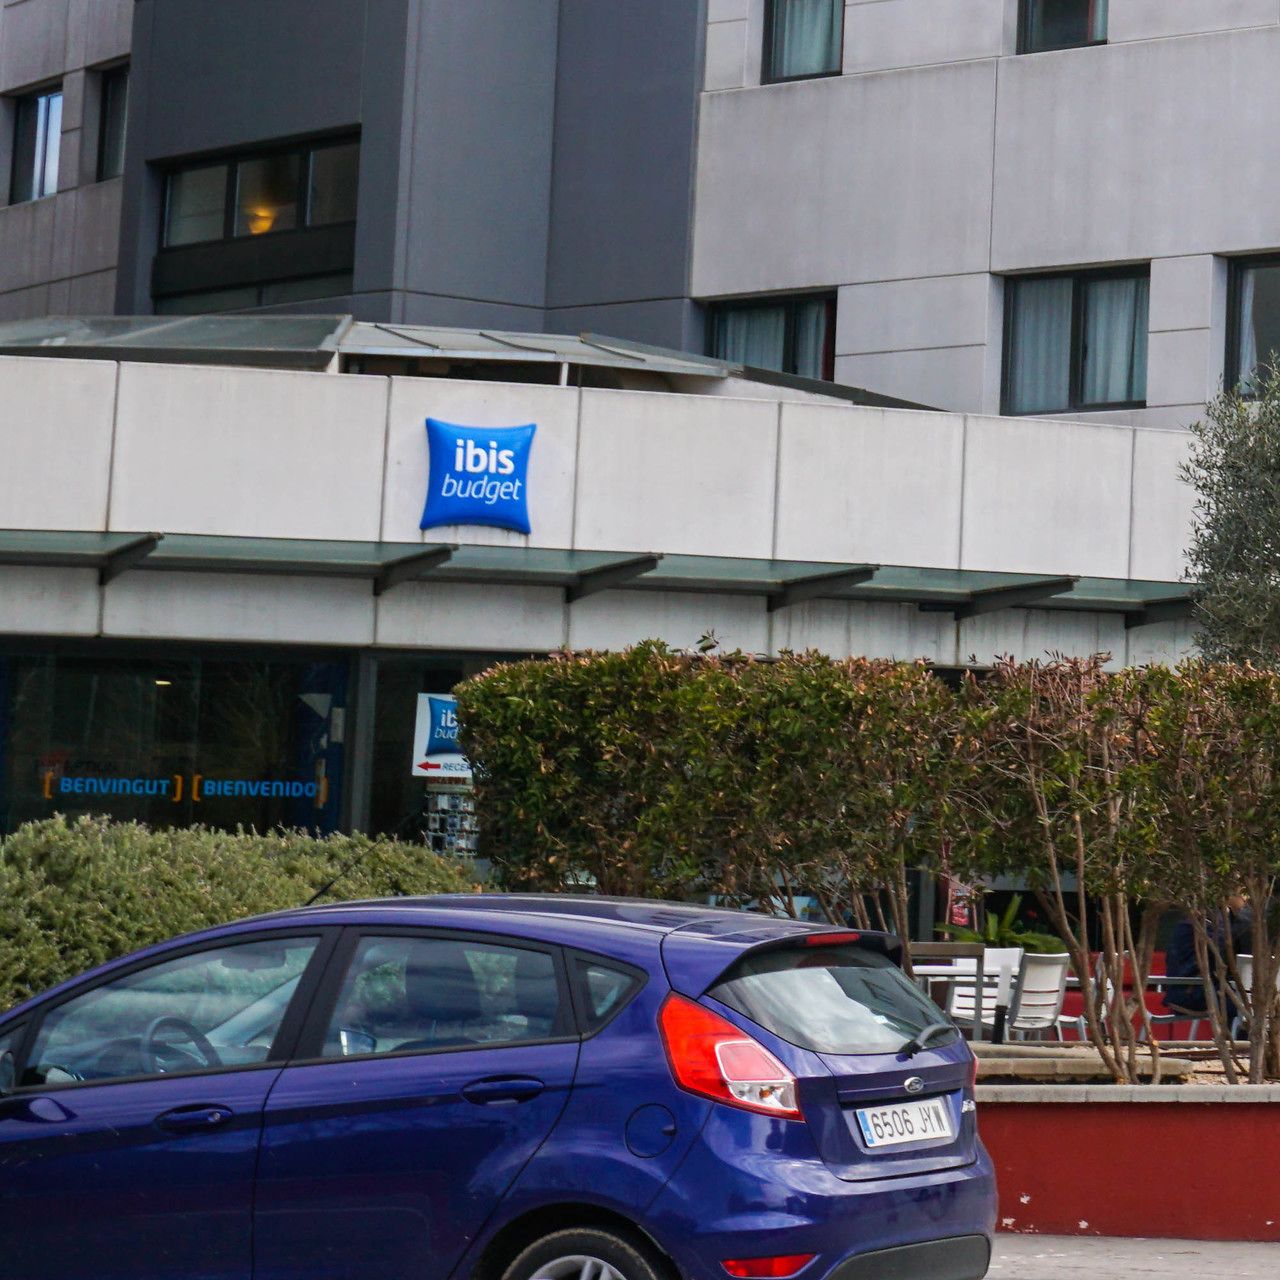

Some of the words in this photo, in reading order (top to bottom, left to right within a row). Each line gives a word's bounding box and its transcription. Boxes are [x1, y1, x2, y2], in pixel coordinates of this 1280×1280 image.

[455, 438, 515, 475] ibis
[441, 473, 522, 505] budget
[440, 710, 458, 728] ib
[434, 726, 458, 739] bud
[59, 776, 170, 796] BENVINGUT
[203, 778, 317, 798] BIENVENIDO
[870, 1108, 914, 1139] 6506
